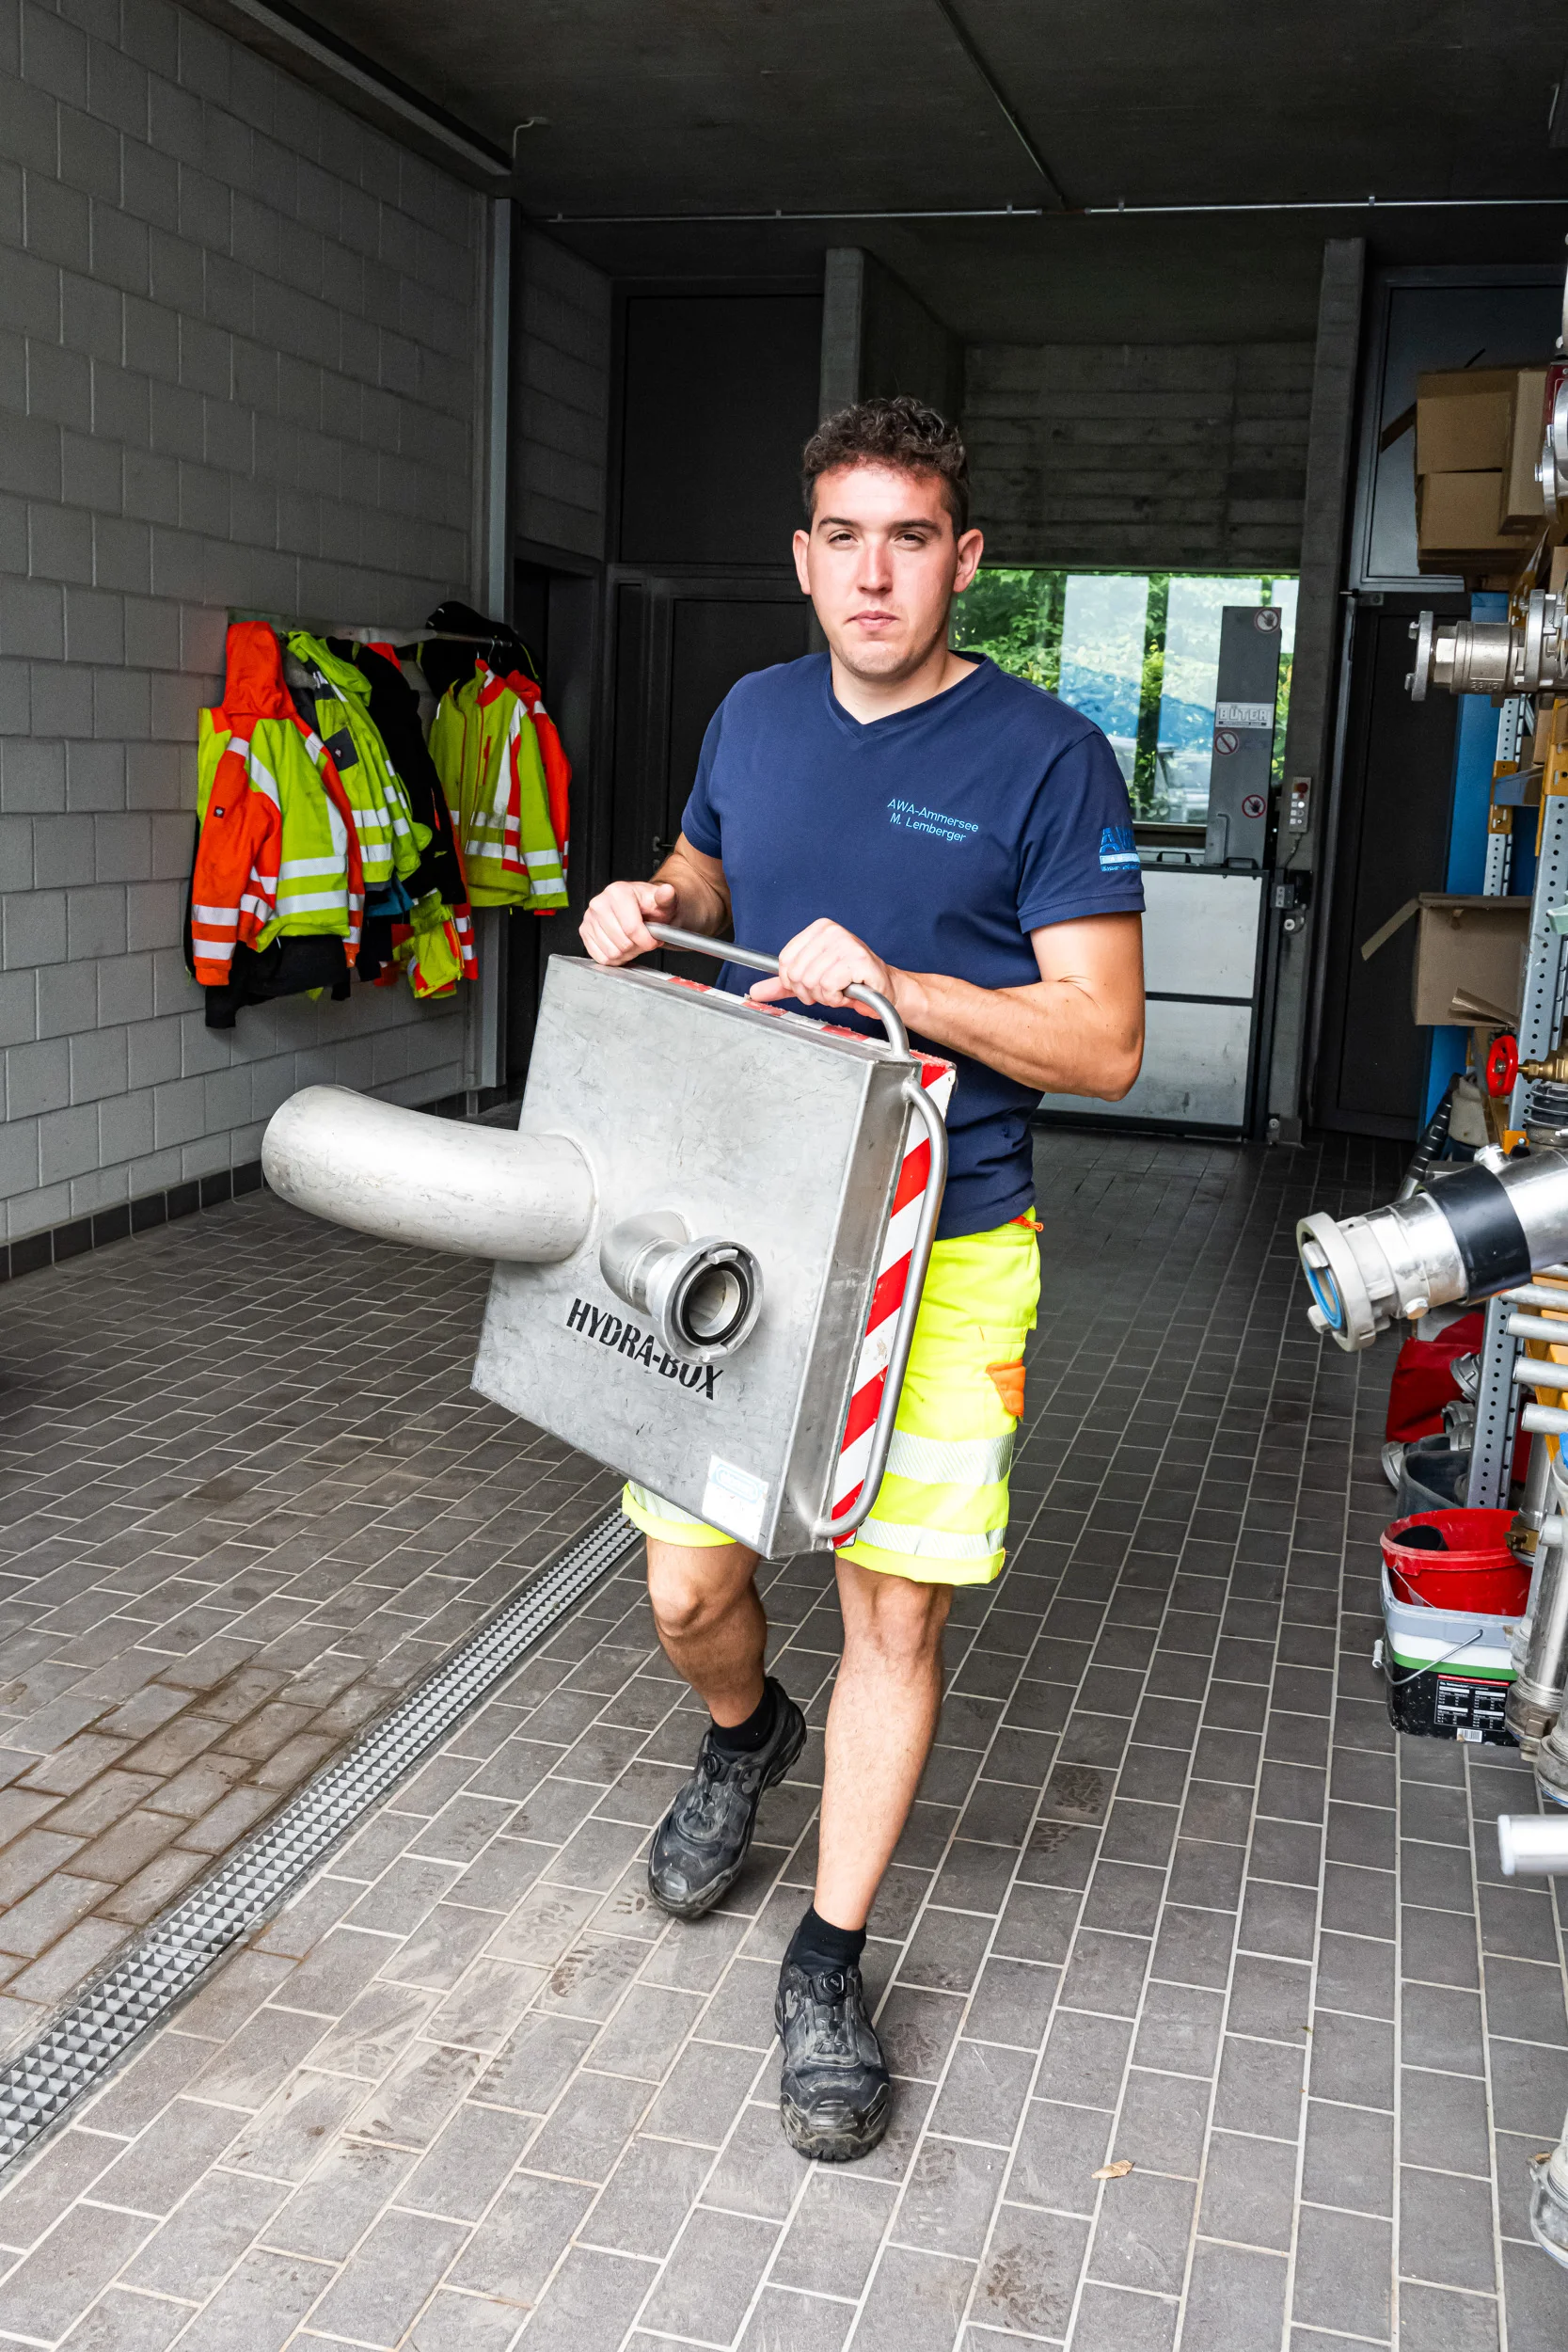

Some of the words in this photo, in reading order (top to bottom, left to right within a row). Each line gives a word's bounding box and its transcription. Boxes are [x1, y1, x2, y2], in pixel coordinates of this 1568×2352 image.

[887, 798, 979, 833] AWA-Ammersee
[889, 812, 901, 825] M.
[906, 817, 967, 842] Lemberger
[565, 1297, 724, 1401] HYDRA-BOX
